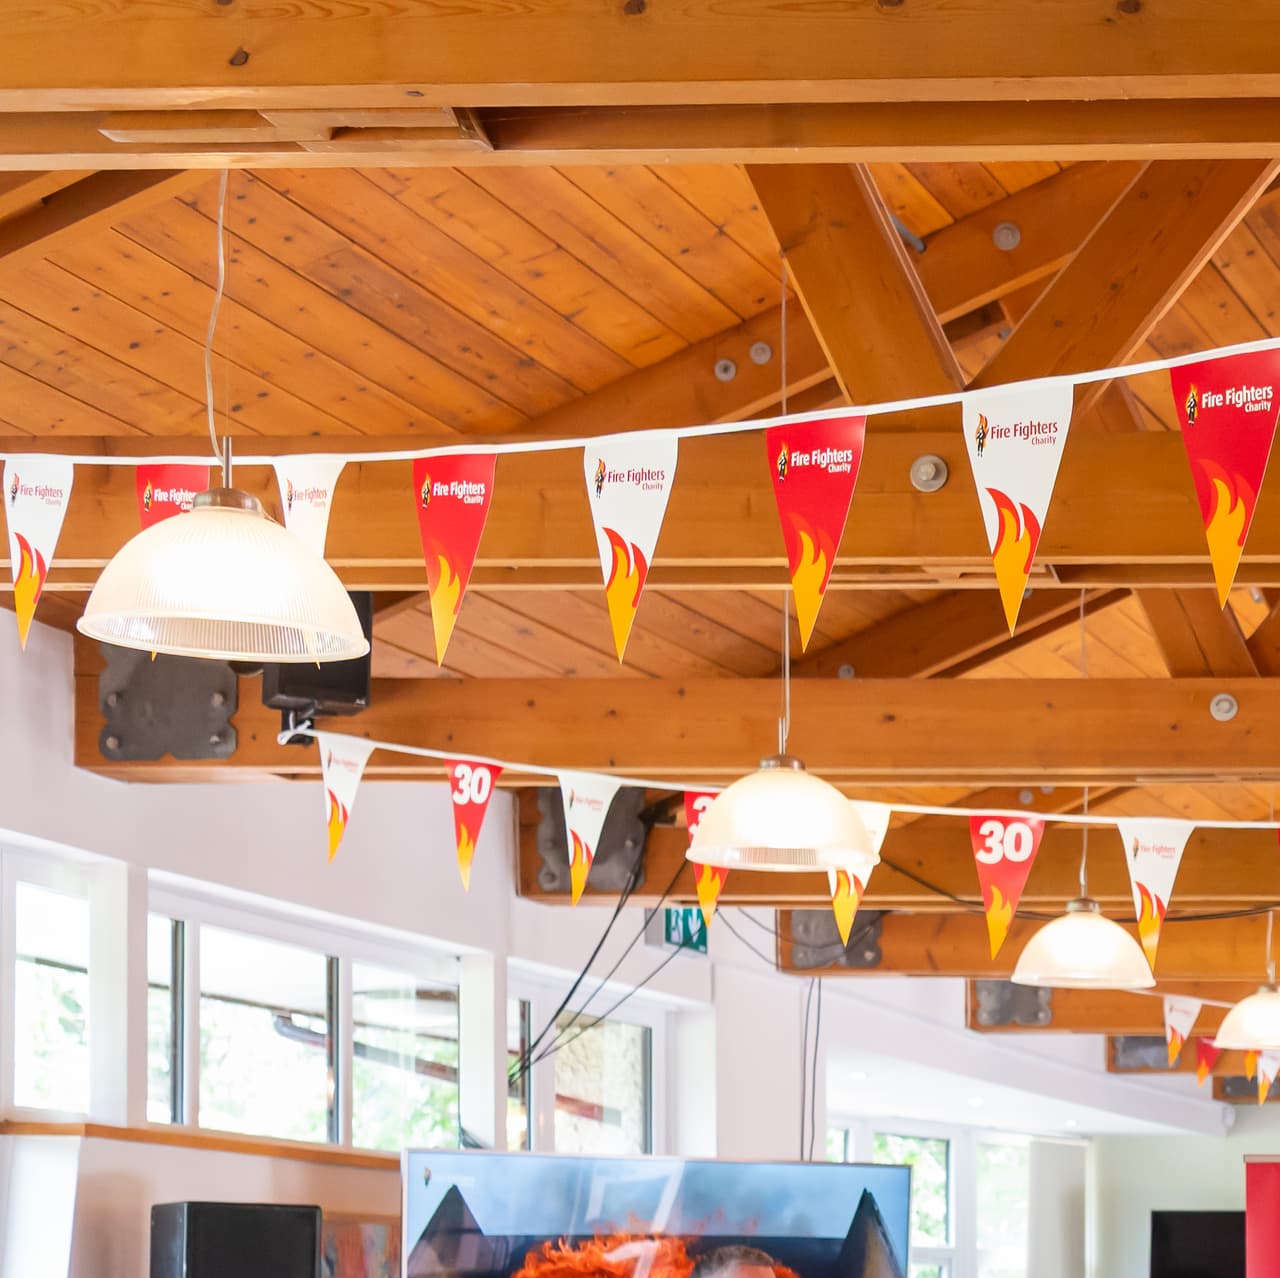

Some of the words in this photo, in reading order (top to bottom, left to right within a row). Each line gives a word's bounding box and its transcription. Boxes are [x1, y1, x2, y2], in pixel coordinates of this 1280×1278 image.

[1202, 392, 1223, 409] Fire
[1225, 385, 1273, 408] Fighters
[1244, 400, 1271, 413] Charity
[991, 424, 1010, 439] Fire
[1014, 420, 1058, 440] Fighters
[1032, 435, 1056, 446] Charity
[791, 451, 810, 467] Fire
[812, 448, 853, 468] Fighters
[608, 469, 625, 483] Fire
[627, 467, 665, 486] Fighters
[828, 463, 852, 473] Charity
[20, 485, 32, 496] Fire
[35, 485, 63, 500] Fighters
[154, 488, 169, 501] Fire
[170, 488, 197, 504] Fighter
[433, 481, 449, 496] Fire
[450, 480, 485, 499] Fighters
[642, 482, 663, 491] Charity
[453, 763, 491, 805] 30
[976, 820, 1033, 864] 30
